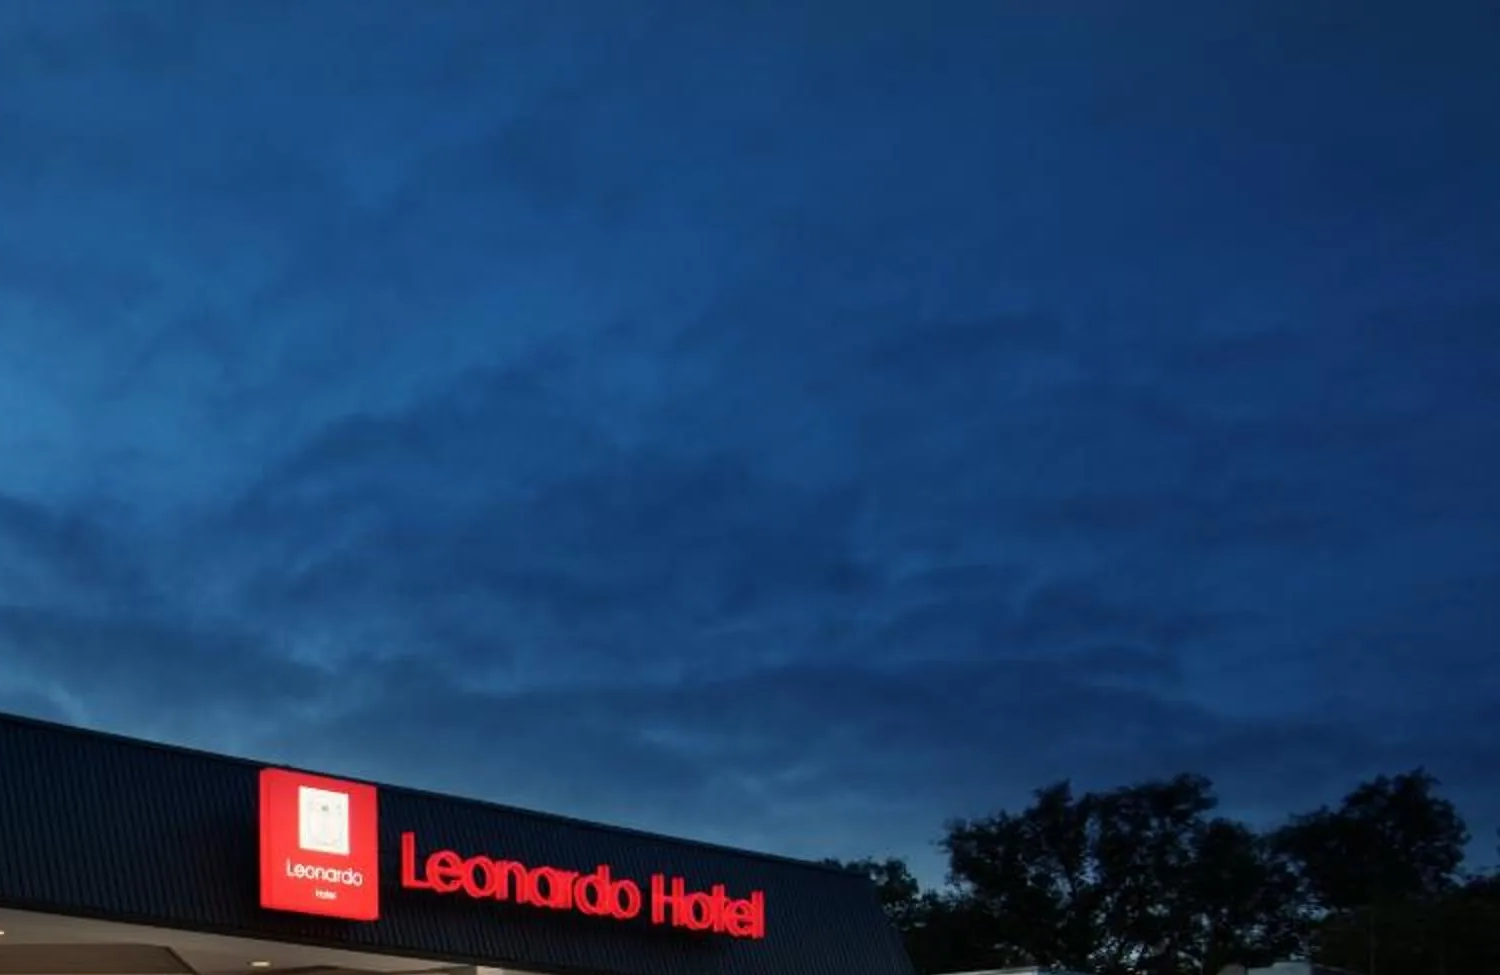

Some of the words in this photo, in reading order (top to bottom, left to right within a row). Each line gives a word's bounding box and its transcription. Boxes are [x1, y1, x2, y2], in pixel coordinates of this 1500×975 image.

[285, 858, 363, 887] Leonardo
[402, 831, 642, 919] Leonardo
[651, 873, 764, 938] Hotel
